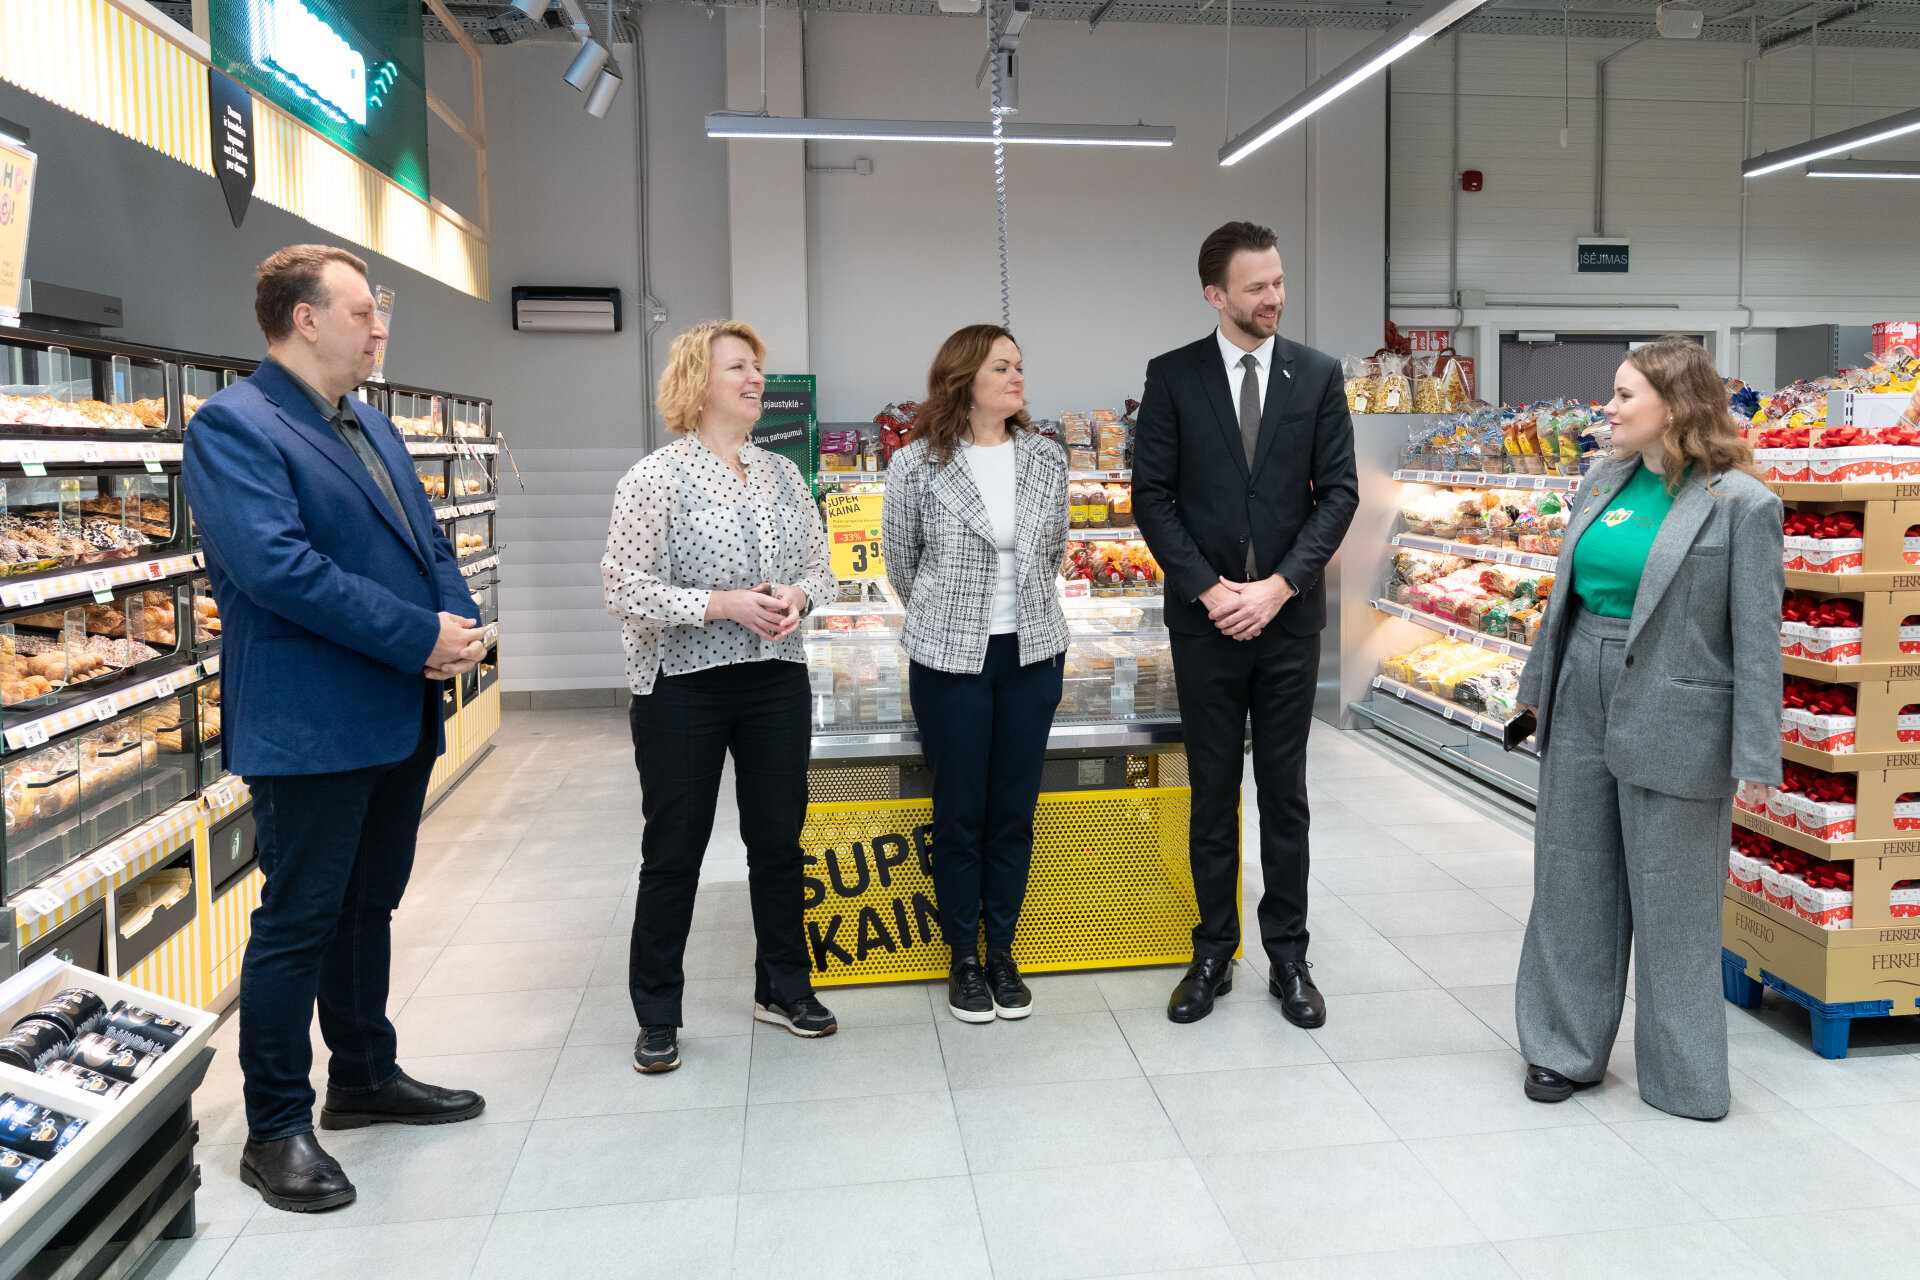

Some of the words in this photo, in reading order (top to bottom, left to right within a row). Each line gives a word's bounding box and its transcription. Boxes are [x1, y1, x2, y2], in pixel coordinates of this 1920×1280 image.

[1580, 252, 1628, 265] IŠĖJIMAS
[763, 399, 799, 409] pjaustyklė
[769, 427, 803, 442] patogumui
[828, 503, 861, 518] KAINA
[840, 533, 862, 542] -33%
[852, 544, 868, 572] 3
[1744, 814, 1774, 836] FERRERO
[803, 822, 934, 910] SUPE
[1740, 892, 1770, 914] FERRERO
[807, 891, 941, 972] KAIN
[1735, 912, 1774, 943] FERRERO
